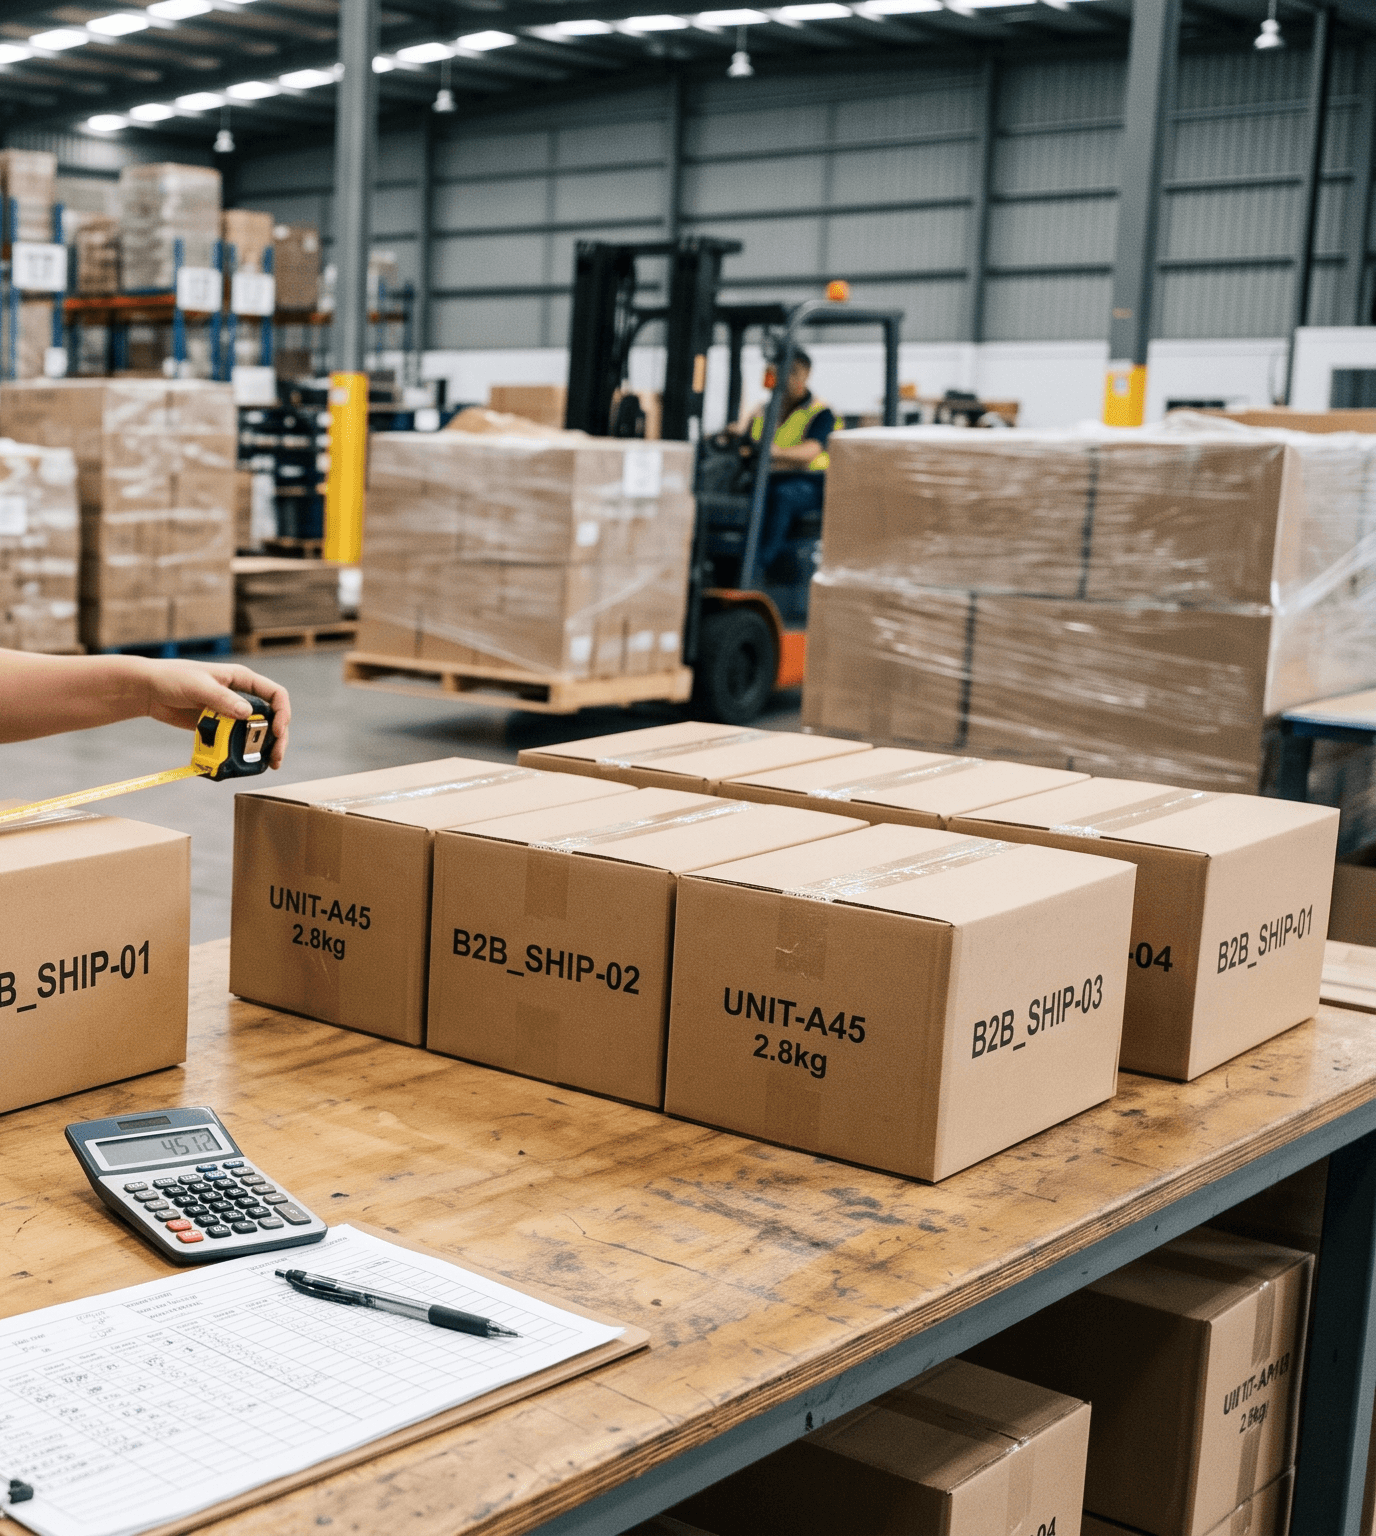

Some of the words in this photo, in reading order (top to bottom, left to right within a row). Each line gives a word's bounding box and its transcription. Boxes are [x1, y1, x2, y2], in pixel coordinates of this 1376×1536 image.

[270, 885, 371, 931] UNIT-A45
[292, 923, 346, 961] 2.8kg
[453, 928, 640, 995] B2B_SHIP-02
[1217, 904, 1313, 974] B2B_SHIP-01
[723, 986, 866, 1044] UNIT-A45
[971, 974, 1103, 1059] B2B_SHIP-03
[752, 1033, 827, 1080] 2.8kg
[161, 1133, 214, 1156] 4512
